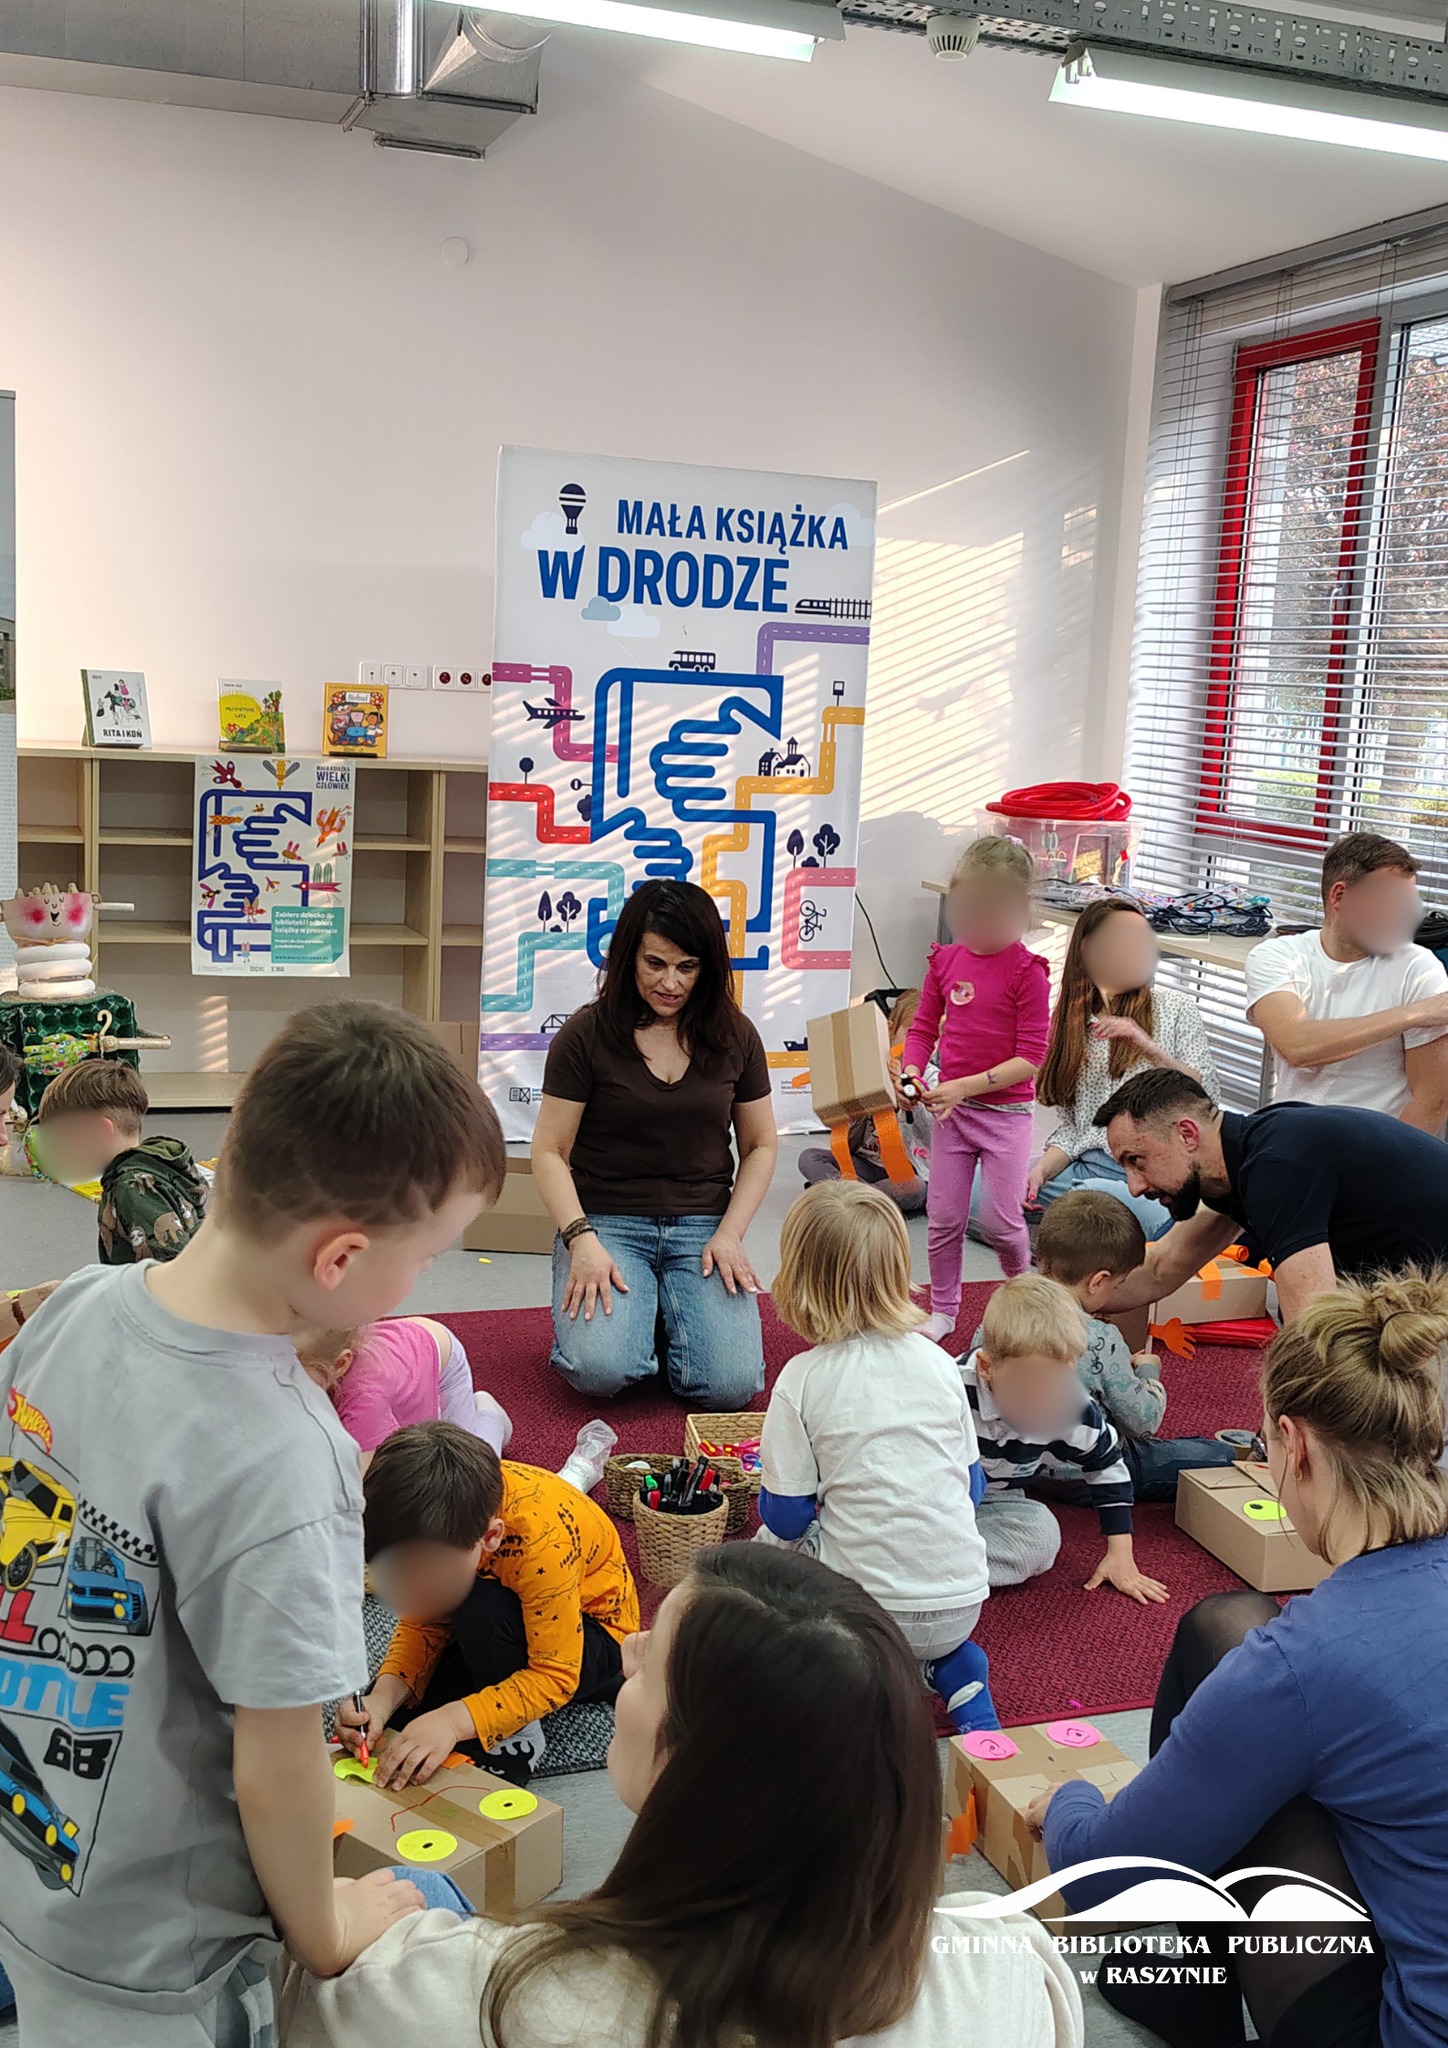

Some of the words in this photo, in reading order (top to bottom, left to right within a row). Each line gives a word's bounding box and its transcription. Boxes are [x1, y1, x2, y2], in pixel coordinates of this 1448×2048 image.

[617, 499, 707, 540] MAŁA
[715, 504, 848, 555] KSIĄŻKA
[537, 545, 586, 600] W
[597, 546, 789, 613] DRODZE
[103, 729, 120, 738] RITA
[126, 728, 142, 739] KOŃ
[316, 771, 350, 782] WIELKI
[316, 782, 350, 790] CZŁOWIEK
[43, 1727, 113, 1780] 68
